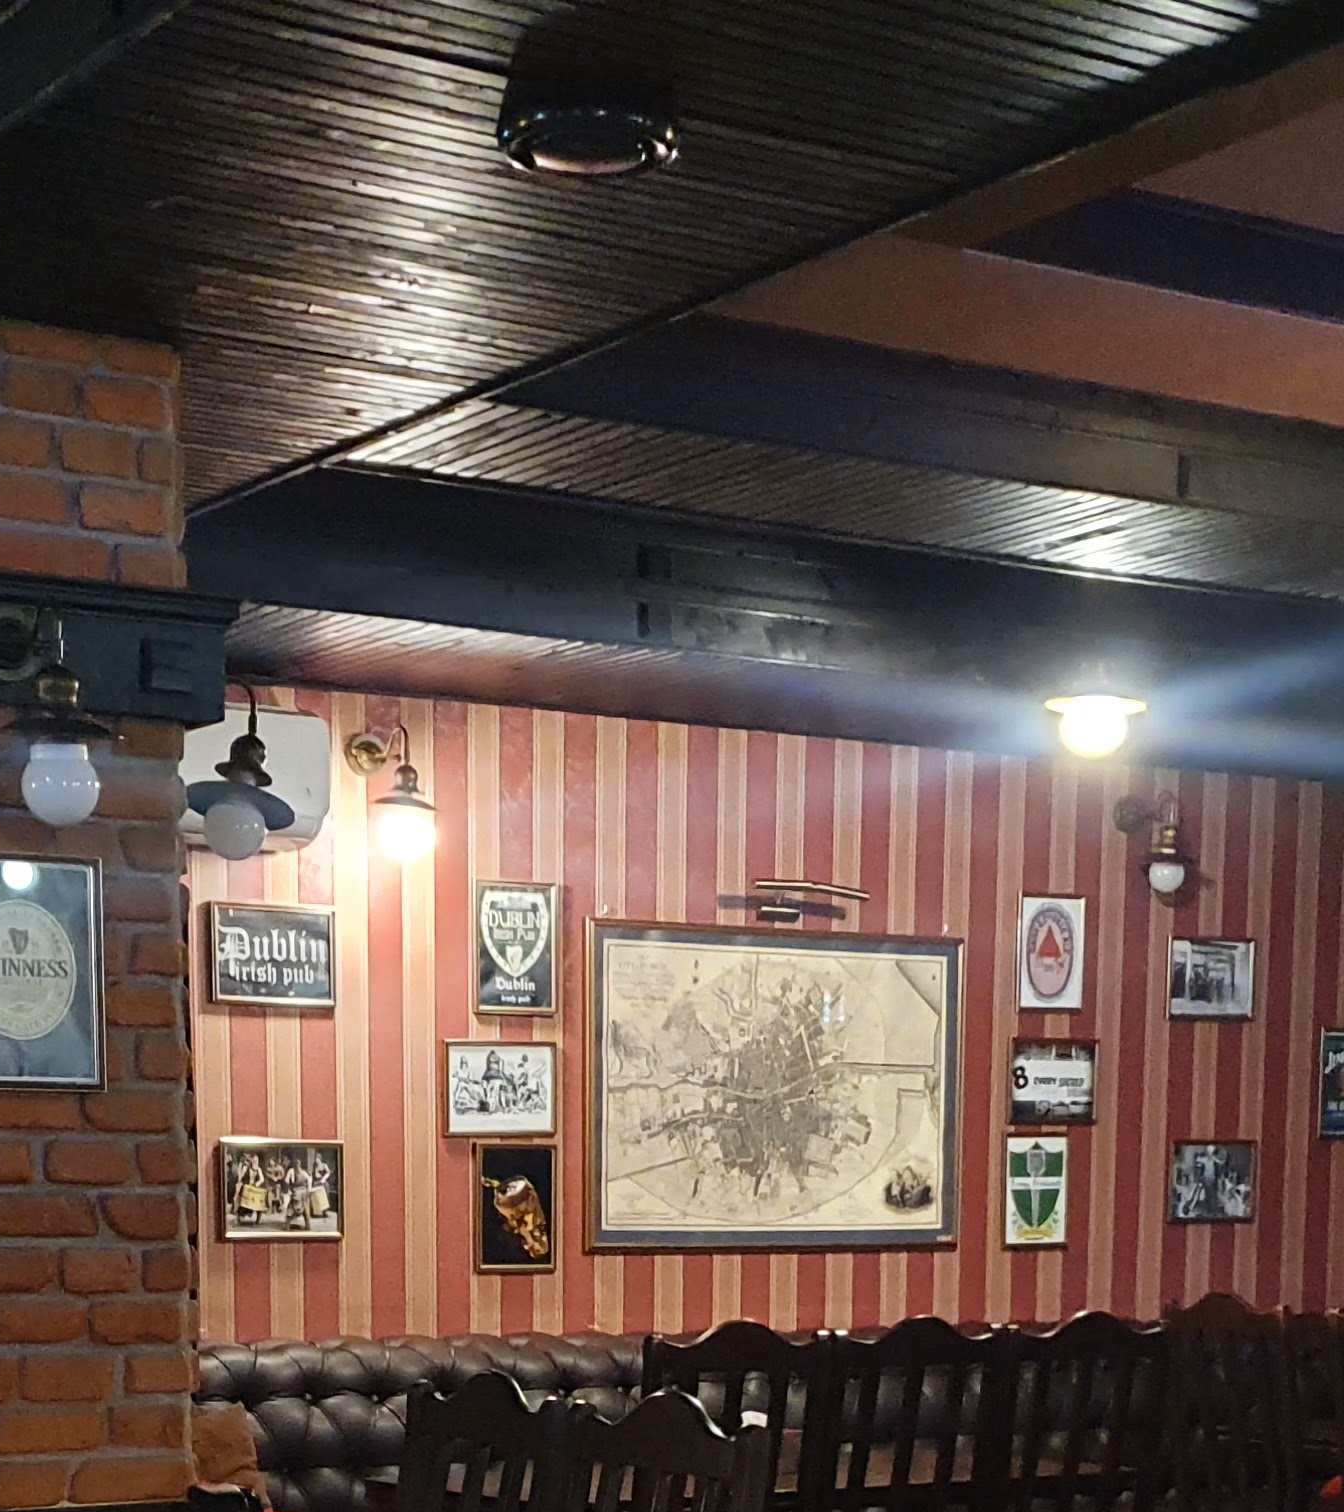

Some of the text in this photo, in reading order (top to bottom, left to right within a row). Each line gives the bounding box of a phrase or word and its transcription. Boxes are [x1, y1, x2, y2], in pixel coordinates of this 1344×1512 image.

[487, 909, 542, 929] DUBLIN
[218, 926, 328, 977] Dublin
[235, 962, 314, 986] irish pub
[494, 976, 536, 992] Dublin
[1012, 1065, 1029, 1090] 8
